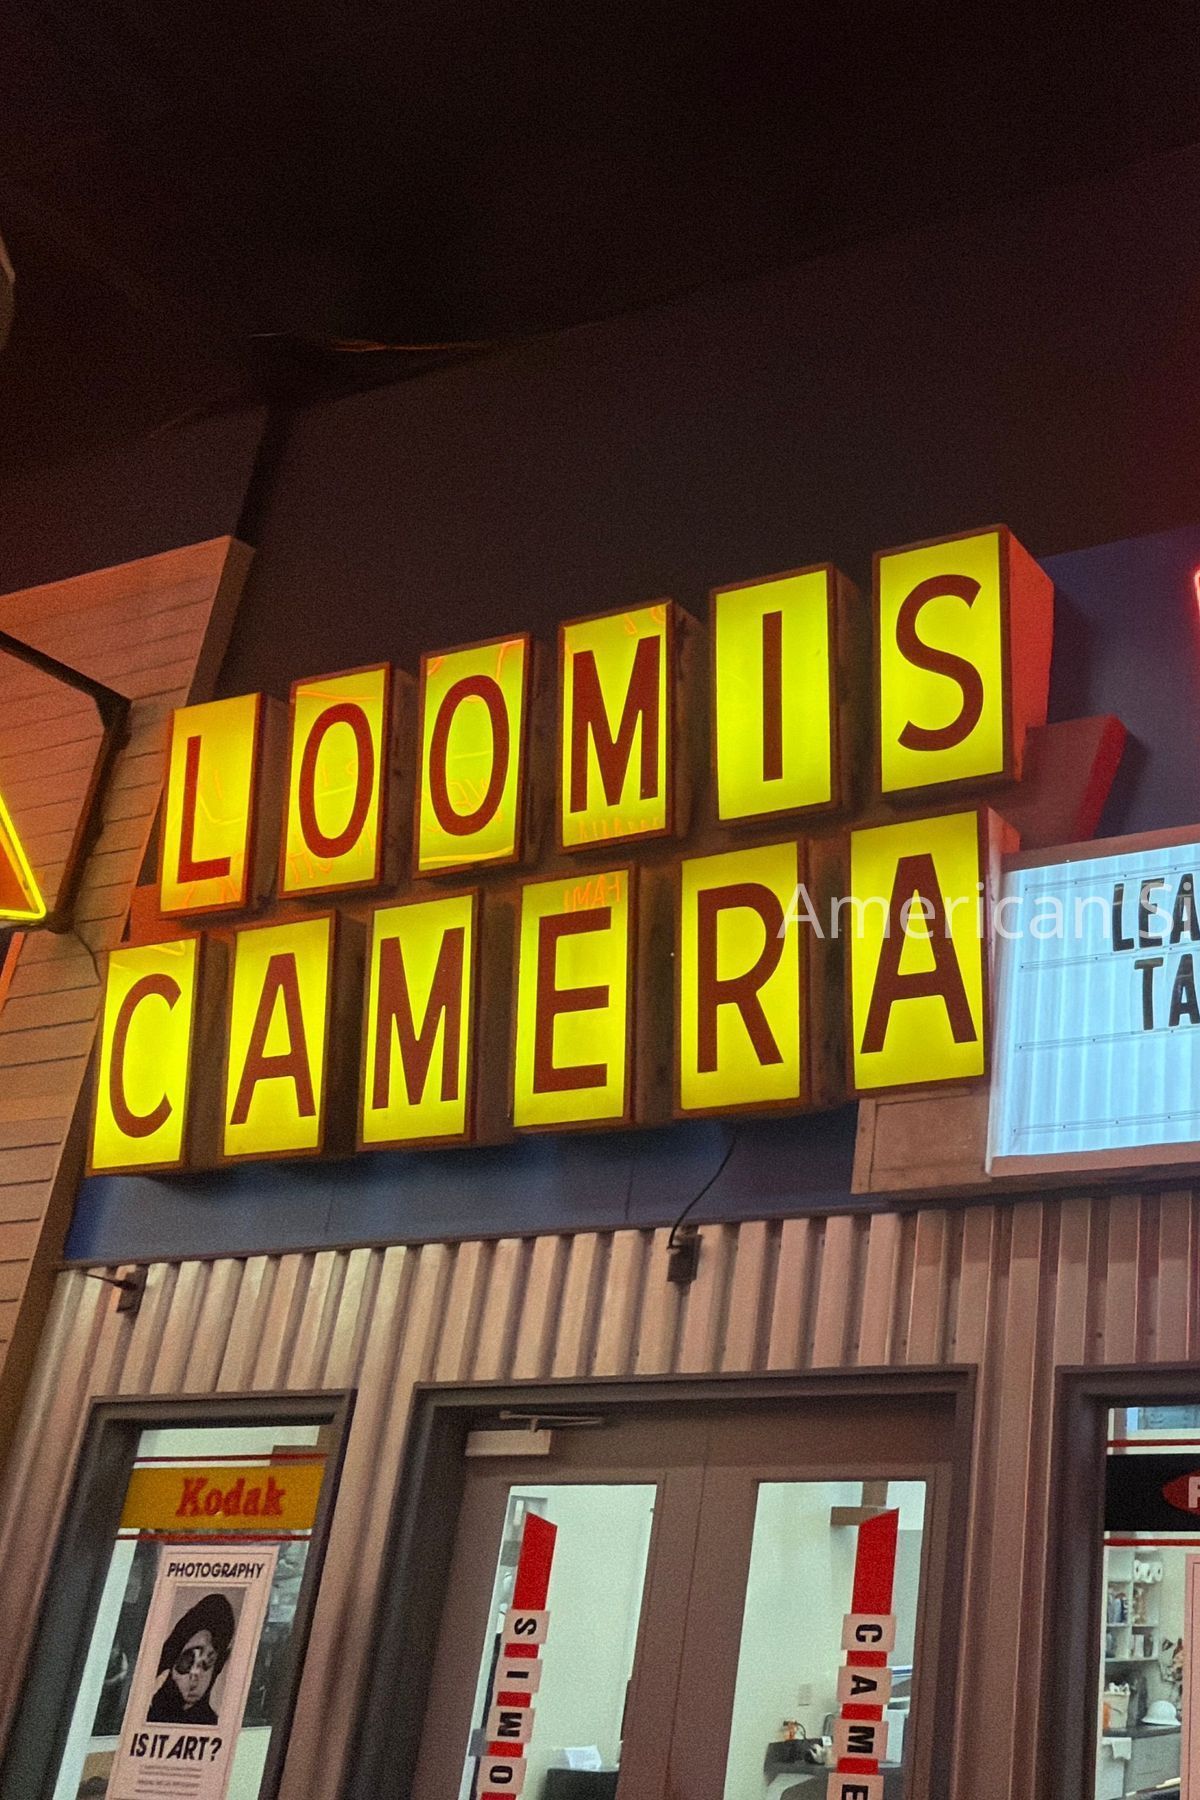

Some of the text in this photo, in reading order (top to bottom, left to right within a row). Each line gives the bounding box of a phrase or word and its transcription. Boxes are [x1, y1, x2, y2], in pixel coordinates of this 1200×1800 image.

[175, 574, 983, 883] LOOMIS
[108, 854, 978, 1138] CAMERA
[175, 1475, 288, 1518] Kodak
[167, 1562, 266, 1580] PHOTOGRAPHY
[130, 1733, 223, 1762] IS IT ART?
